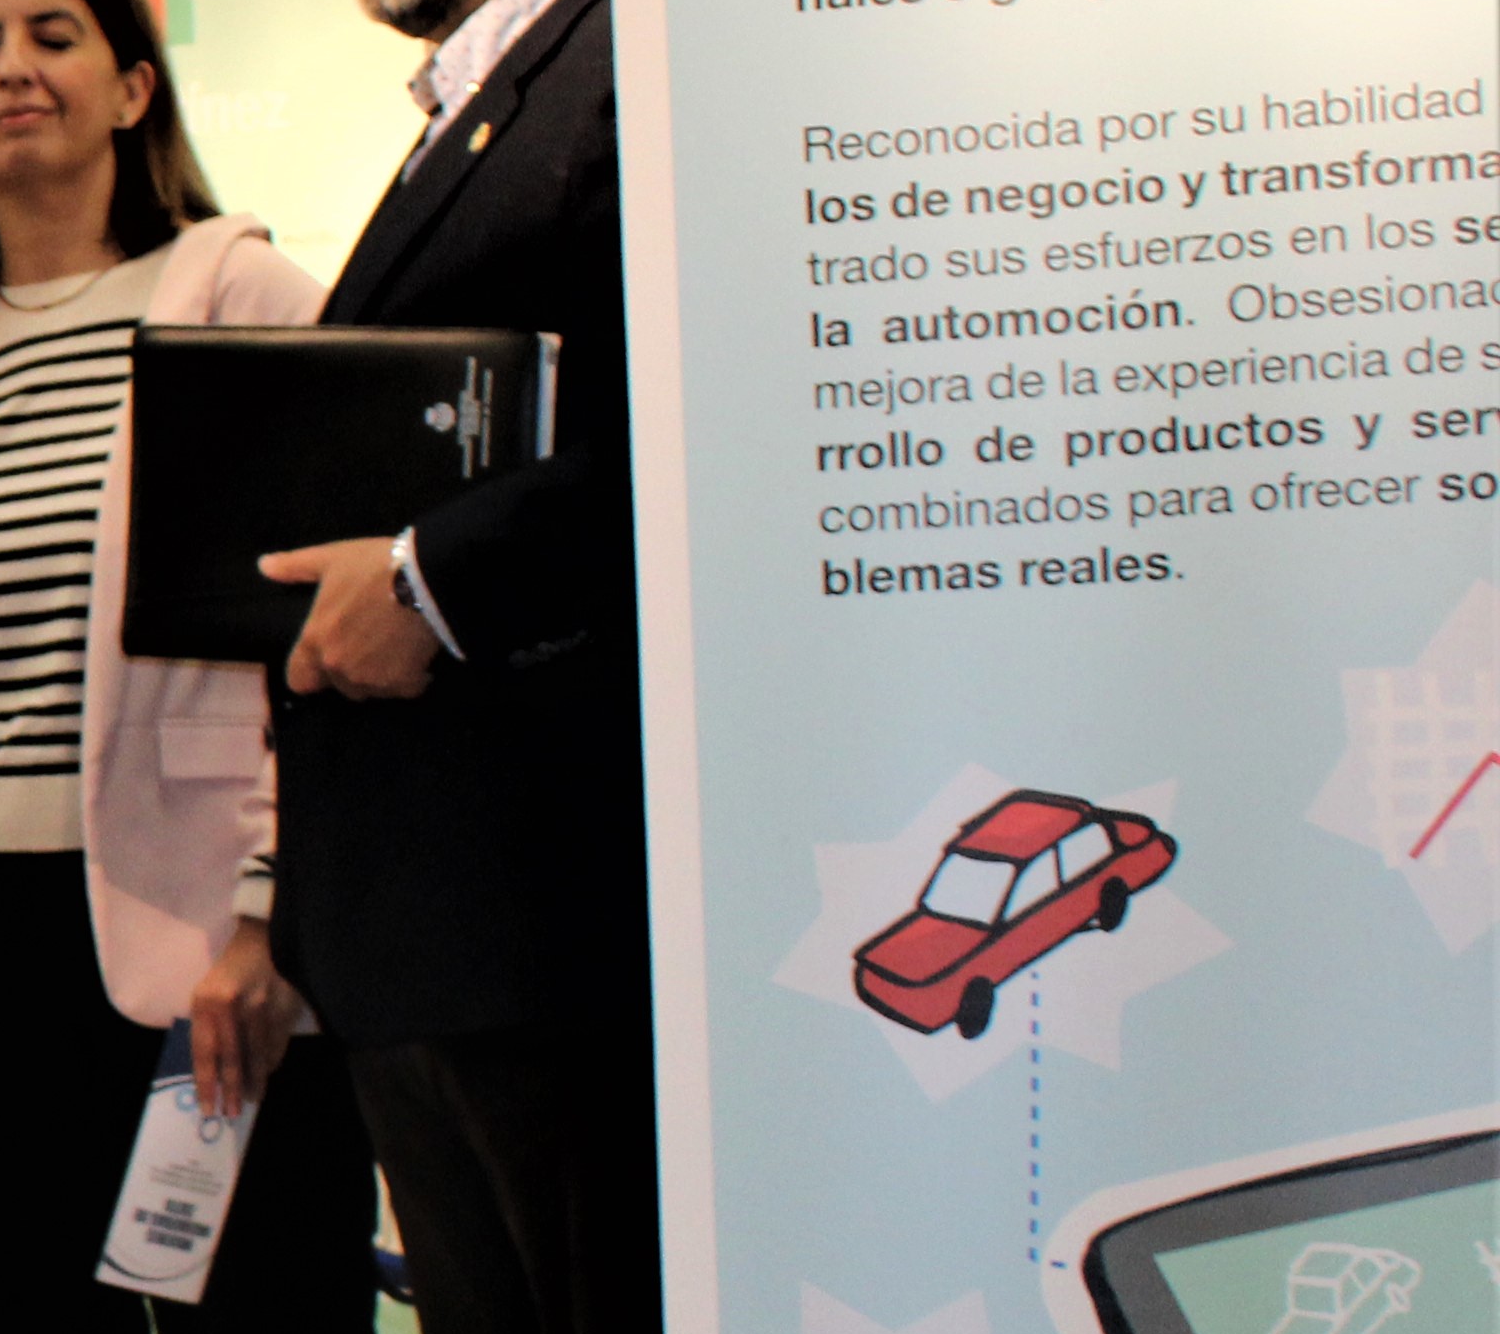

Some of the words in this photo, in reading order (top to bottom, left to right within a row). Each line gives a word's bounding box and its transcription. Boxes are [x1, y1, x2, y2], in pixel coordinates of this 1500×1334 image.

[804, 111, 1082, 163] Reconocida
[1099, 111, 1176, 152] por
[1192, 106, 1245, 136] su
[1263, 79, 1483, 130] habilidad
[806, 189, 875, 224] los
[891, 182, 949, 219] de
[966, 168, 1165, 219] negocio
[1181, 173, 1205, 208] y
[807, 246, 928, 286] trado
[946, 247, 1026, 278] sus
[1044, 230, 1273, 272] esfuerzos
[1290, 225, 1346, 255] en
[1367, 214, 1435, 249] los
[812, 313, 850, 347] la
[883, 290, 1193, 344] automoción.
[815, 370, 972, 415] mejora
[987, 363, 1044, 400] de
[1061, 361, 1099, 396] la
[1113, 342, 1389, 399] experiencia
[1405, 337, 1465, 375] de
[818, 431, 944, 471] rrollo
[975, 426, 1034, 463] de
[1066, 414, 1323, 467] productos
[1354, 414, 1380, 450] y
[819, 487, 1110, 534] combinados
[1129, 486, 1233, 527] para
[1251, 472, 1420, 512] ofrecer
[823, 559, 1001, 596] blemas
[1021, 547, 1183, 586] reales.
